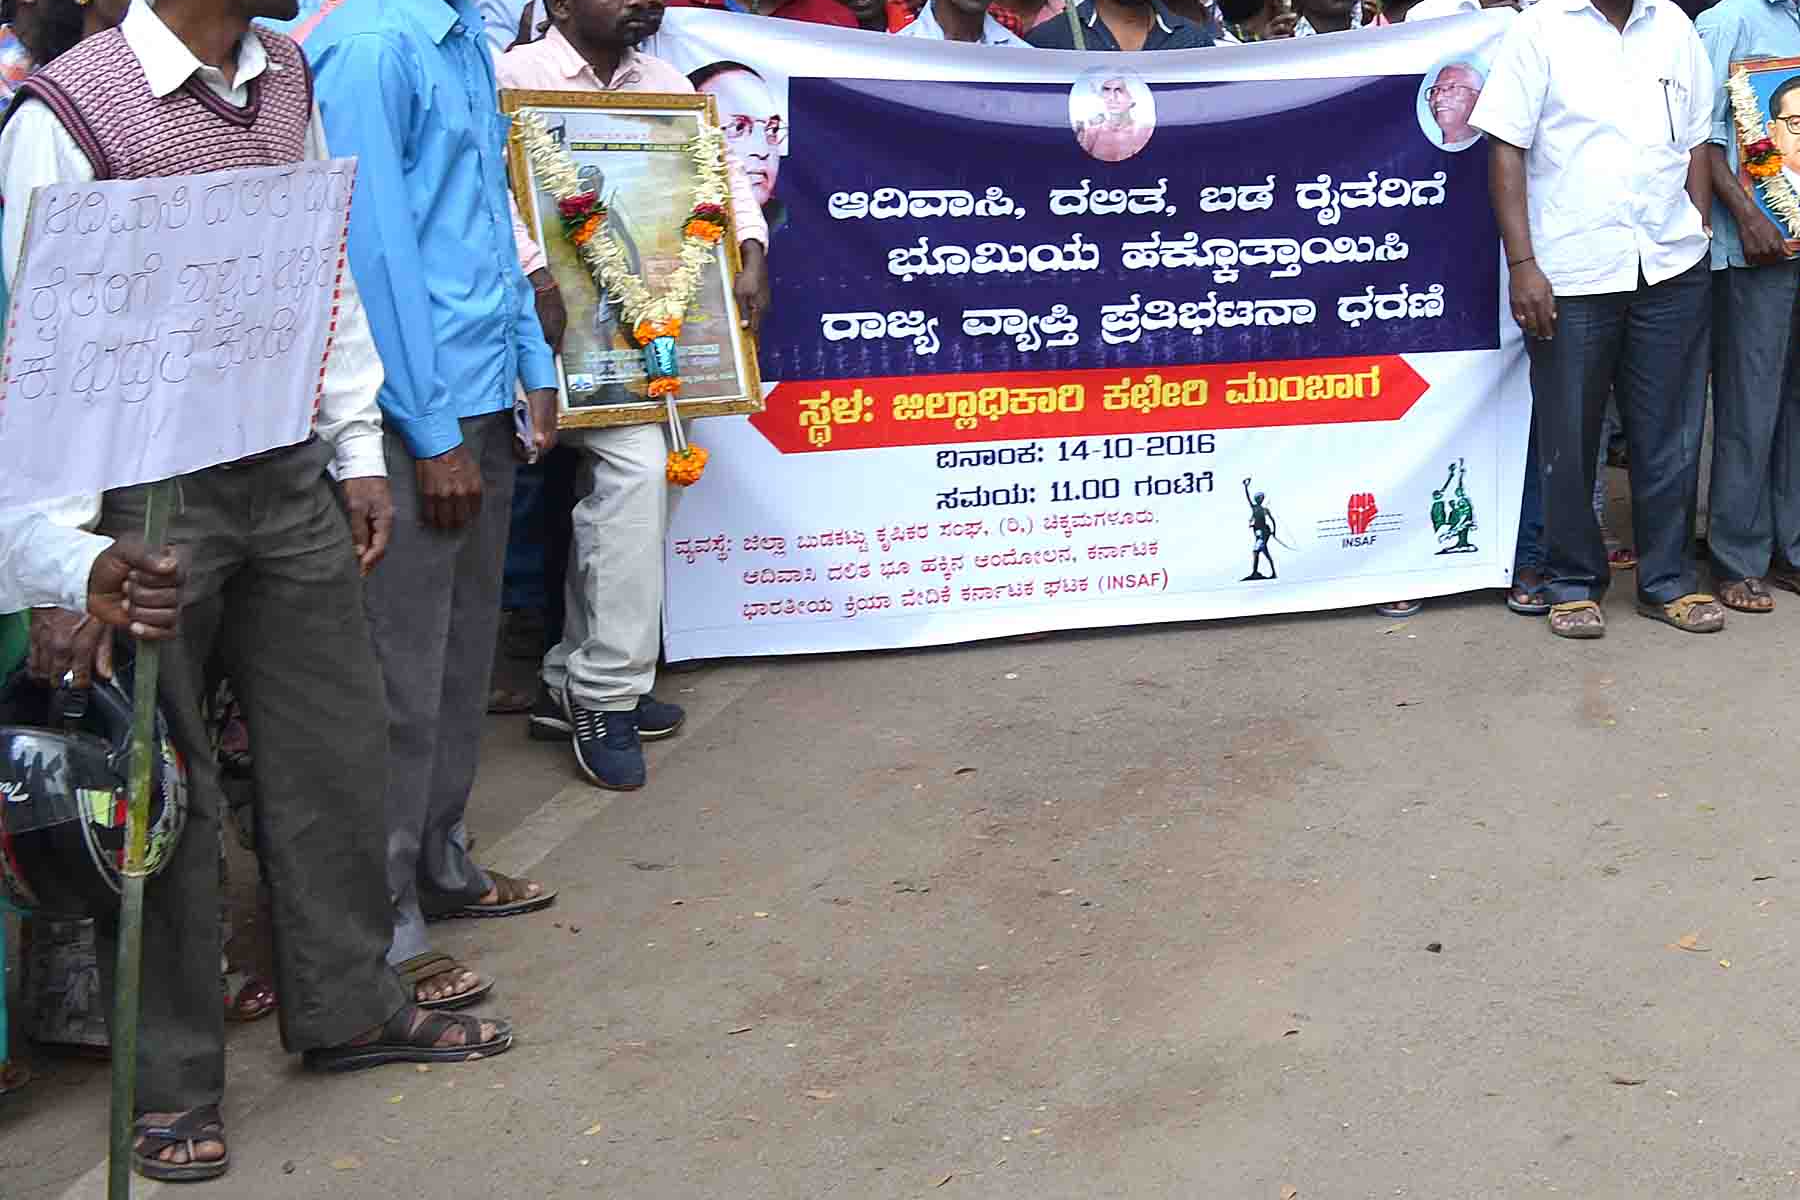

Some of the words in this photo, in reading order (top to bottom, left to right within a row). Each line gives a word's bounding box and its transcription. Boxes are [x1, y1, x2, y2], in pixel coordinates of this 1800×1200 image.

[827, 186, 1026, 220] ಆದಿವಾಸಿ,
[1049, 178, 1177, 216] ದಲಿತ,
[1199, 174, 1276, 213] ಬಡ
[1294, 170, 1448, 226] ರೈತರಿಗೆ
[887, 232, 1101, 282] ಭೂಮಿಯ
[1120, 230, 1410, 284] ಹಕ್ಕೊತ್ತಾಯಿಸಿ
[820, 309, 941, 356] ರಾಜ್ಯ
[961, 303, 1081, 352] ವ್ಯಾಪ್ತಿ
[1100, 291, 1317, 345] ಪ್ರತಿಭಟನಾ
[1336, 282, 1446, 328] ಧರಣಿ
[798, 388, 875, 448] ಸ್ಥಳ:
[892, 383, 1086, 431] ಜಿಲ್ಲಾಧಿಕಾರಿ
[1102, 374, 1209, 415] ಕಛೇರಿ
[1224, 364, 1382, 406] ಮುಂಬಾಗ
[936, 441, 1045, 470] ದಿನಾಂಕ:
[1057, 433, 1216, 462] 14-10-2016
[935, 482, 1037, 510] ಸಮಯ:
[1050, 478, 1120, 503] 11.00
[1134, 471, 1214, 498] ಗಂಟೆಗೆ
[743, 535, 786, 558] ಜಿಲ್ಲಾ
[796, 528, 869, 553] ಬುಡಕಟ್ಟು
[876, 521, 929, 552] ಕೃಷಿಕರ
[743, 567, 817, 585] ಆದಿವಾಸಿ
[827, 561, 872, 581] ದಲಿತ
[880, 559, 912, 578] ಭೂ
[920, 554, 965, 581] ಹಕ್ಕಿನ
[974, 547, 1078, 569] ಆಂದೋಲನ,
[1087, 540, 1160, 560] ಕರ್ನಾಟಕ
[1342, 535, 1377, 549] INSAF
[743, 596, 833, 621] ಭಾರತೀಯ
[841, 593, 891, 618] ಕ್ರಿಯಾ
[900, 584, 952, 608] ವೇದಿಕೆ
[960, 580, 1035, 602] ಕರ್ನಾಟಕ
[1043, 576, 1090, 599] ಘಟಕ
[1097, 567, 1169, 594] (INSAF)
